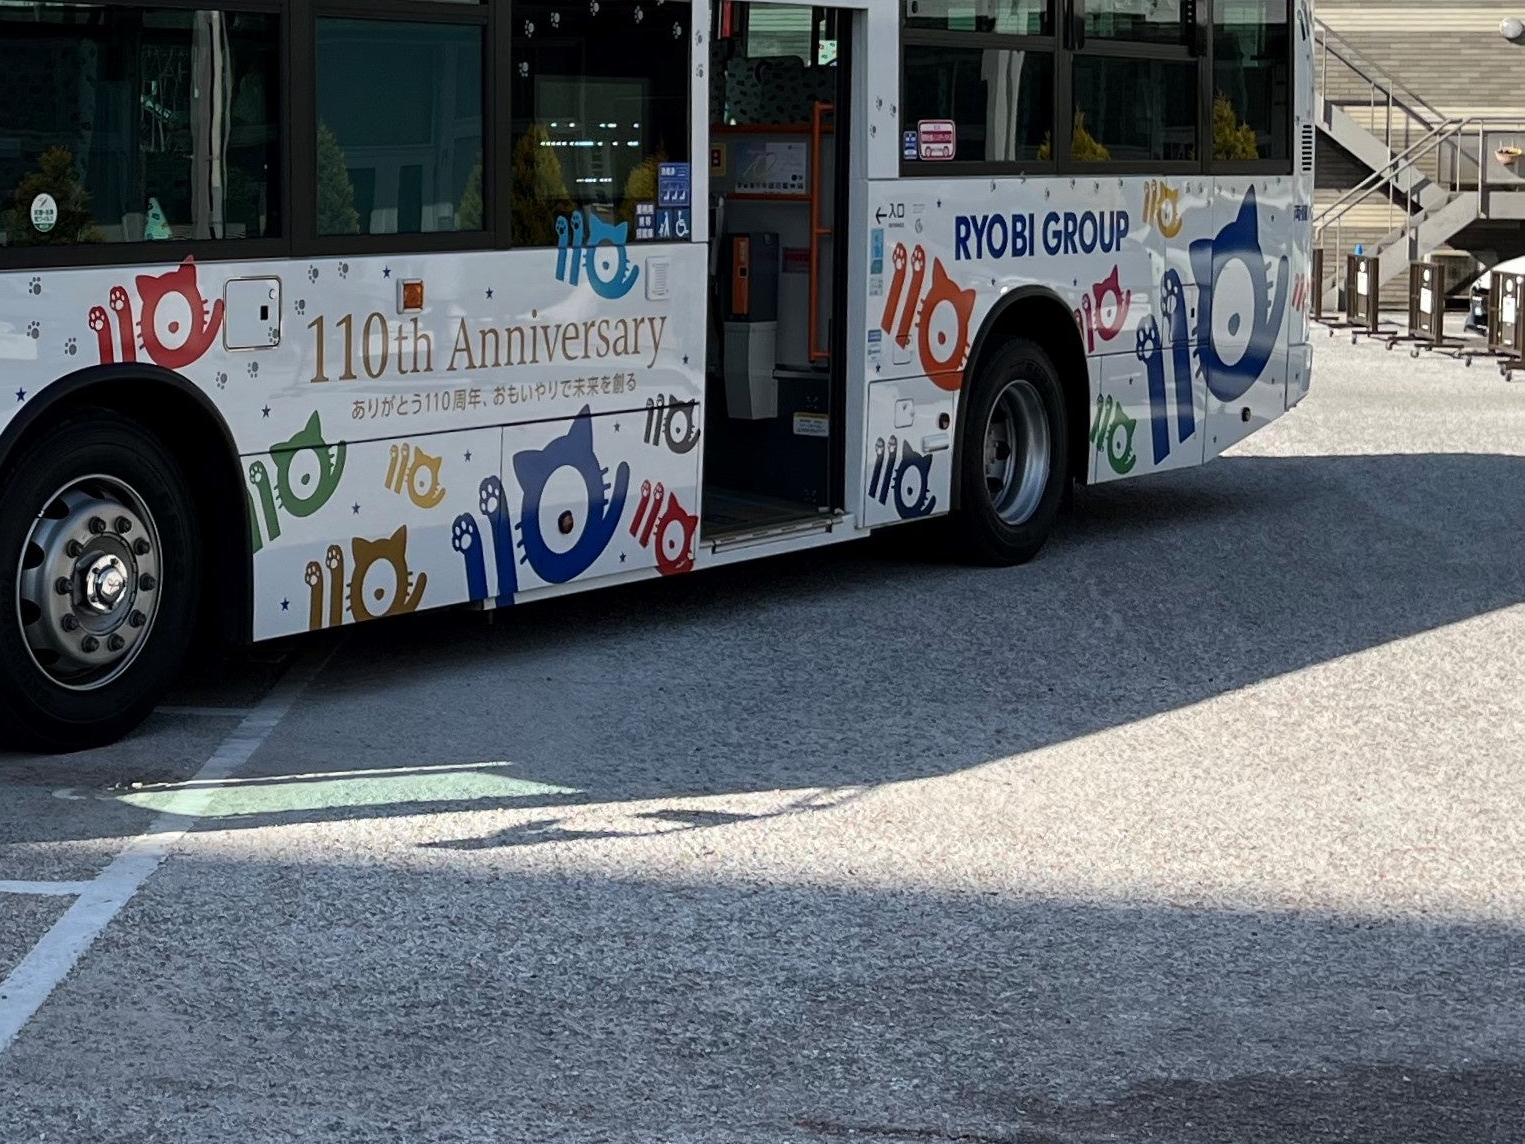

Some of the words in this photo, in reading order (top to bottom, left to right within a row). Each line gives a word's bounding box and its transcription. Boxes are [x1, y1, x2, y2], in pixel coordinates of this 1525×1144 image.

[888, 203, 905, 219] 入口
[955, 213, 1034, 261] RYOBI
[1042, 210, 1130, 256] GROUP
[307, 311, 433, 384] 110th
[446, 309, 667, 371] Anniversary
